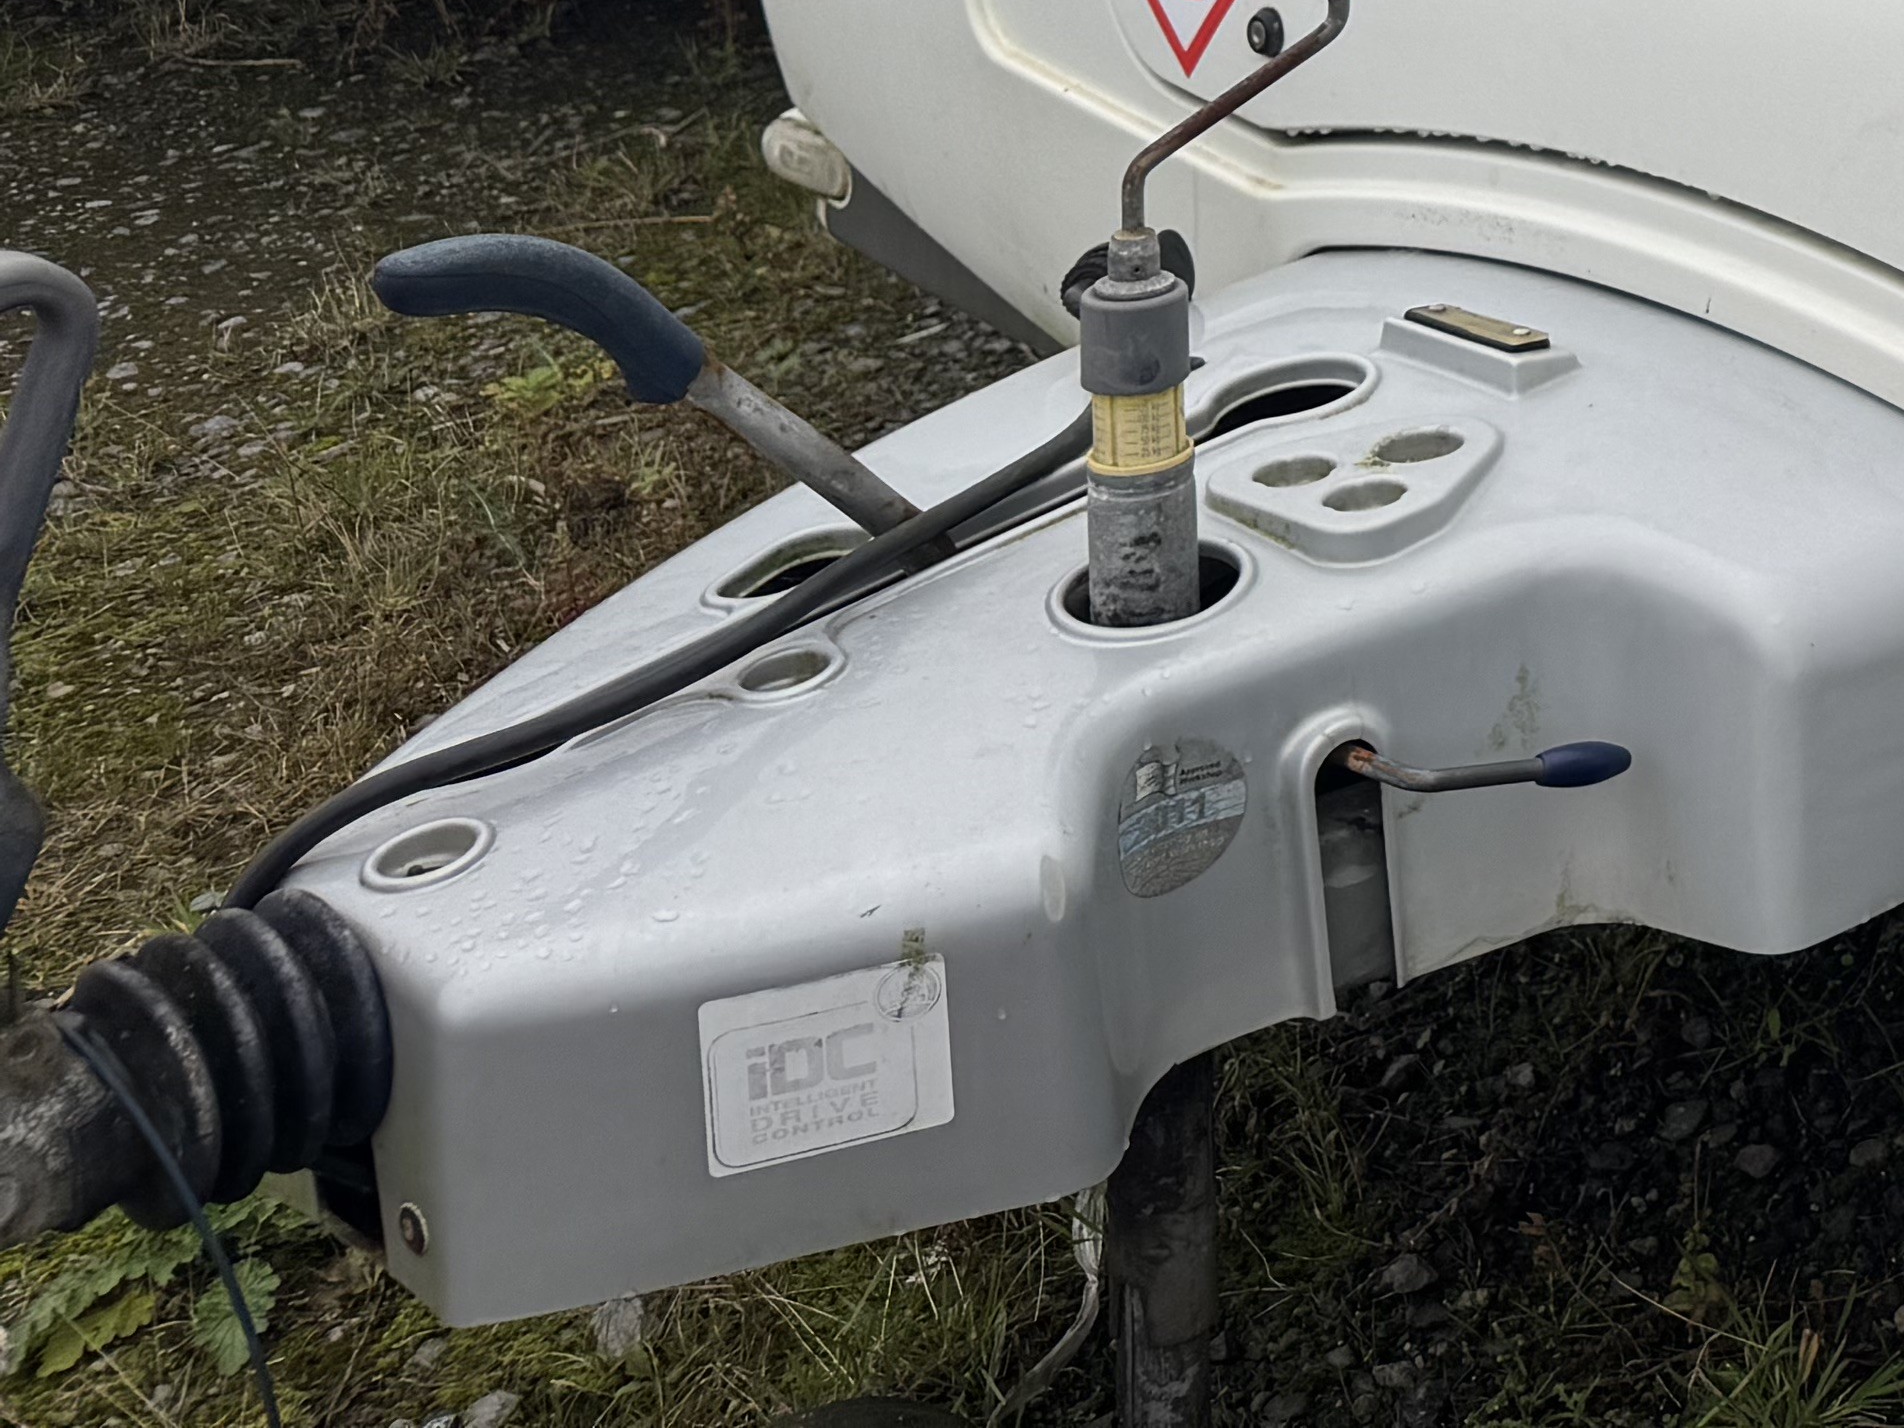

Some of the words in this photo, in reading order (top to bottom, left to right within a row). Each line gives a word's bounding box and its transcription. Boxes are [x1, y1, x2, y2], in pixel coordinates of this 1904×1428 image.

[750, 1079, 879, 1117] INTELLIGENT
[751, 1091, 879, 1133] DRIVE
[752, 1107, 880, 1144] CONTROL
